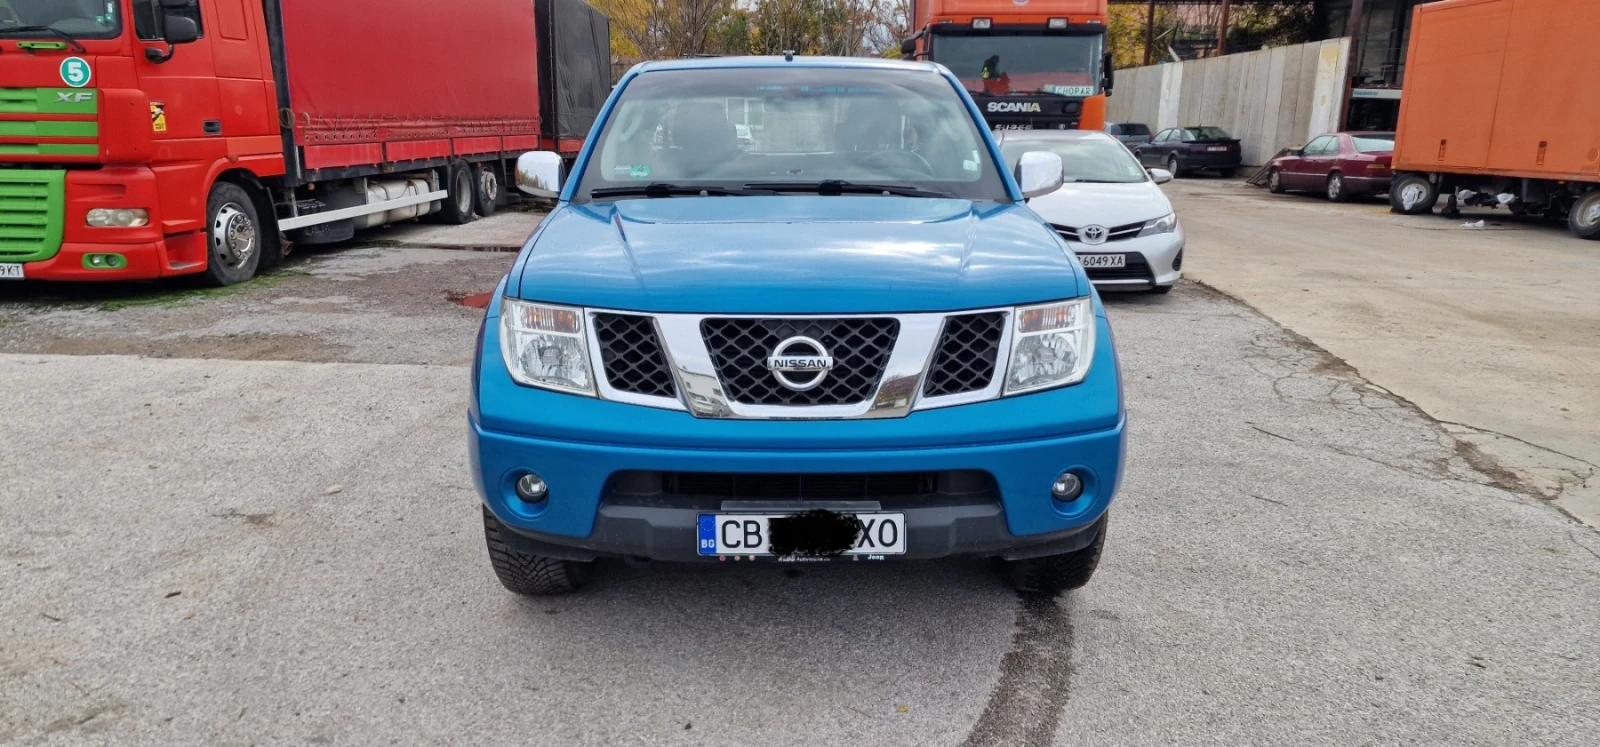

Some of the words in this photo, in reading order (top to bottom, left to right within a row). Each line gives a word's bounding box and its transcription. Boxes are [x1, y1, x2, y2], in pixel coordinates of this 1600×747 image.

[68, 61, 84, 82] 5
[55, 92, 92, 103] XF
[987, 102, 1041, 112] SCANIA
[774, 359, 827, 368] NISSAN
[721, 520, 763, 549] CB
[857, 518, 898, 548] XO
[701, 539, 715, 548] BG
[867, 554, 885, 562] Jeep
